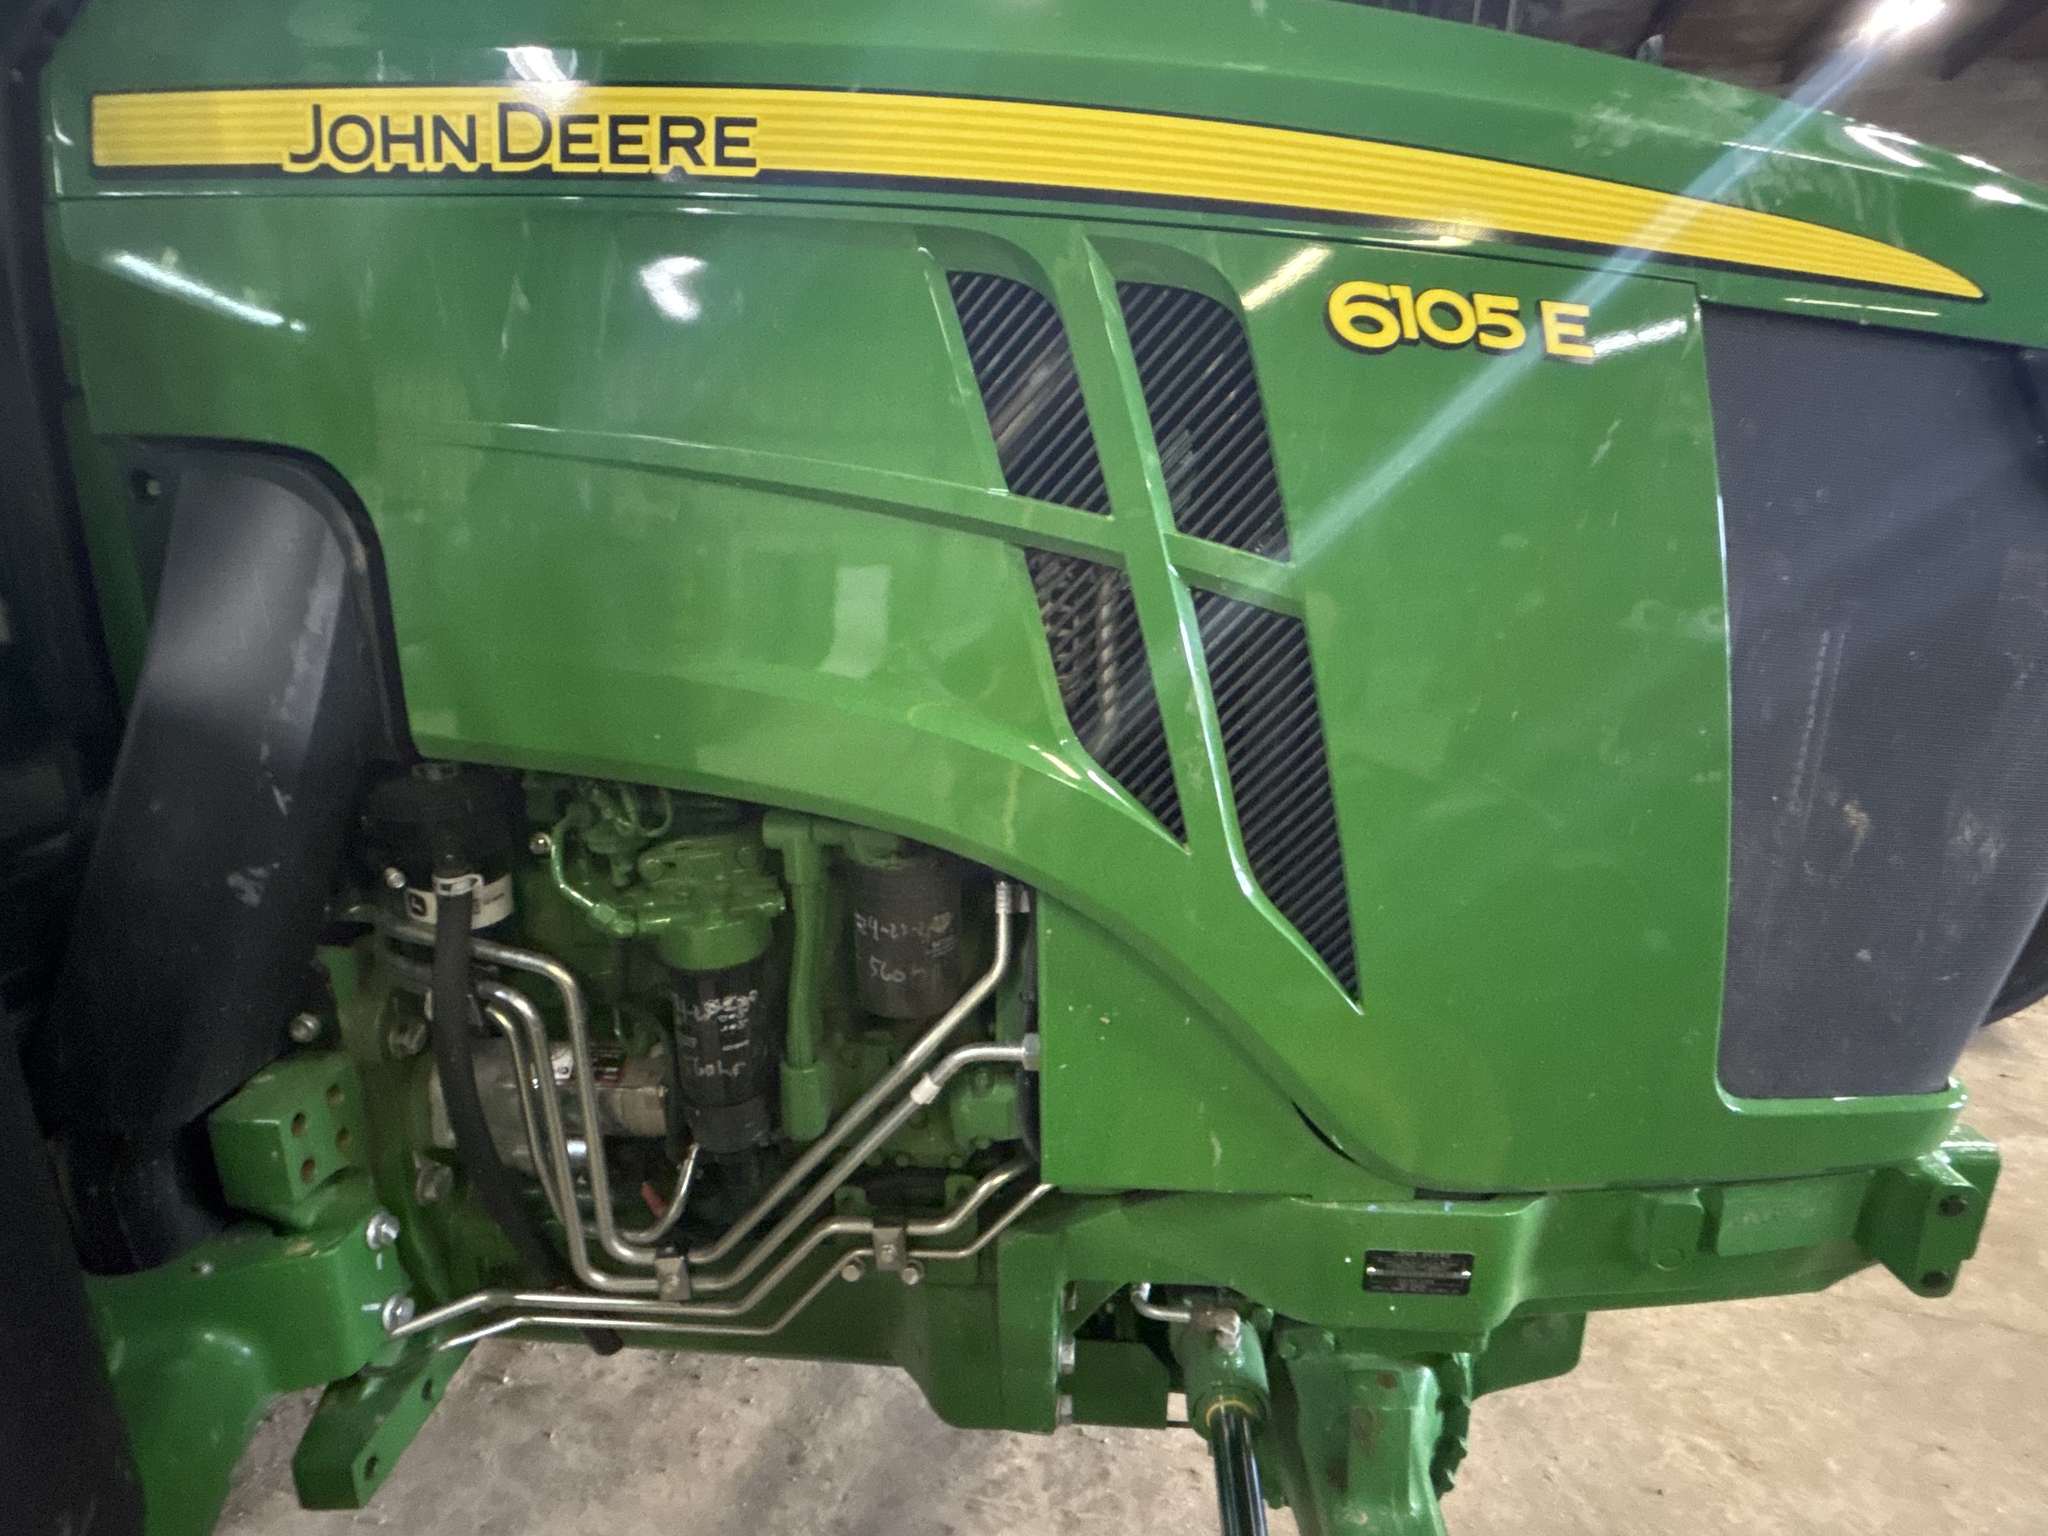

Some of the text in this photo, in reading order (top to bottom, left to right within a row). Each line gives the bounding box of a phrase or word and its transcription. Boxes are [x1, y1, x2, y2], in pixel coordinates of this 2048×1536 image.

[288, 101, 758, 168] JOHN DEERE
[1326, 280, 1595, 361] 6105 E
